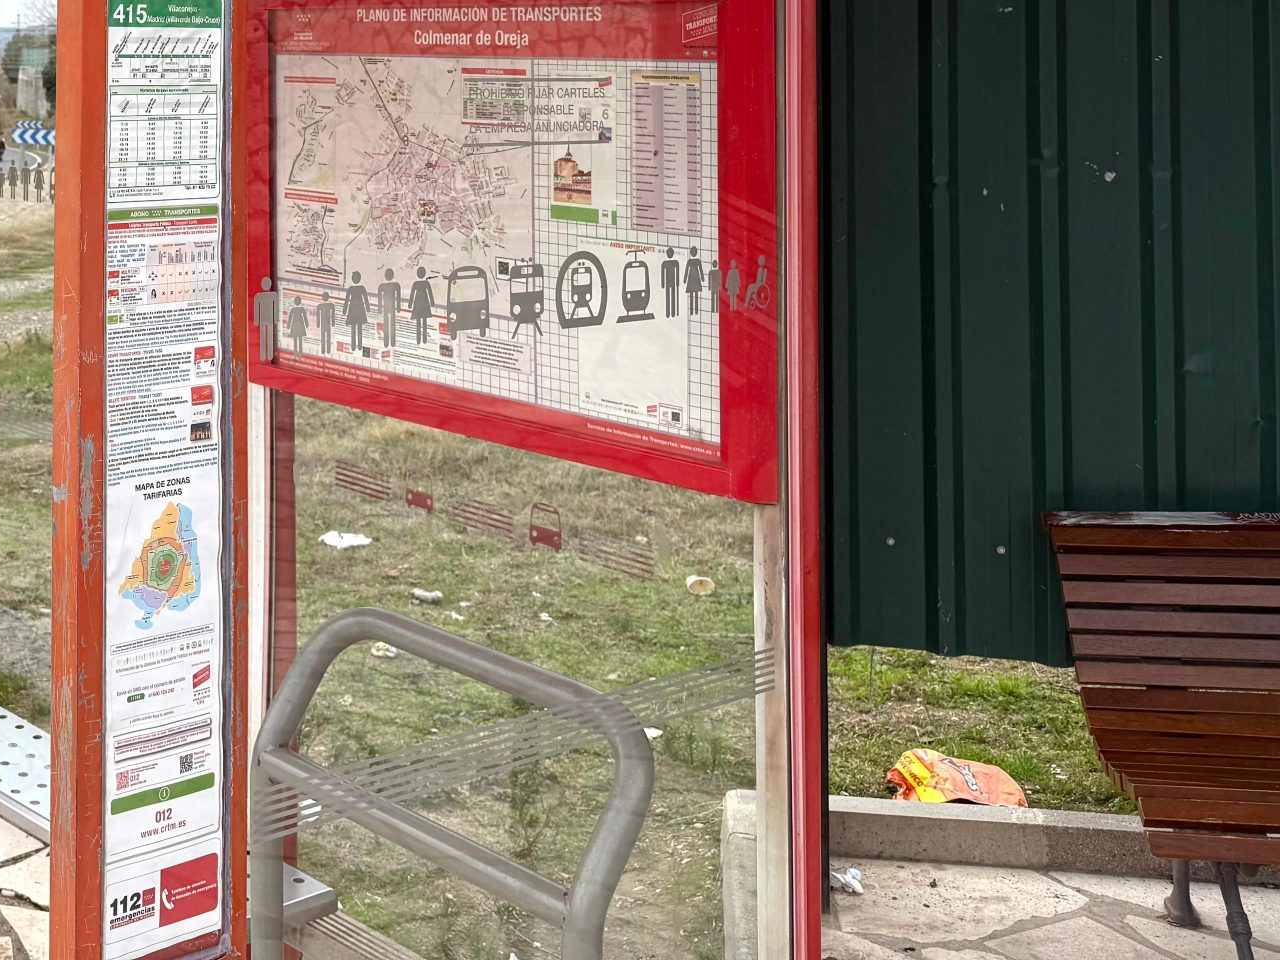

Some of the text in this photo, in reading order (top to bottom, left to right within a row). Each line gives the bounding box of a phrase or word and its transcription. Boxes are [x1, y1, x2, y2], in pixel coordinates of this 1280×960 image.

[112, 3, 148, 24] 415
[167, 4, 198, 14] Villaconejos
[356, 4, 602, 23] PLANO DE INFORMACIÓN DE TRANSPORTES
[147, 15, 165, 23] Madrid
[414, 29, 529, 49] Colmenar de Oreja
[556, 87, 606, 99] CARTELES
[601, 108, 609, 120] 6
[485, 121, 532, 134] EMPRESA
[534, 120, 605, 133] ANUNCIADORA
[164, 208, 201, 216] TRANSPORTES
[624, 243, 656, 253] IMPORTANTE
[587, 422, 605, 432] Servicio
[605, 425, 613, 433] de
[613, 428, 642, 440] Información
[642, 433, 649, 441] de
[680, 443, 712, 456] www.crtm.es
[134, 476, 191, 492] MAPA DE ZONAS
[142, 488, 183, 501] TARIFARIAS
[130, 773, 140, 782] 012
[155, 807, 173, 823] 012
[140, 819, 187, 839] www.crtm.es
[110, 892, 142, 917] 112
[109, 905, 156, 925] emergencias
